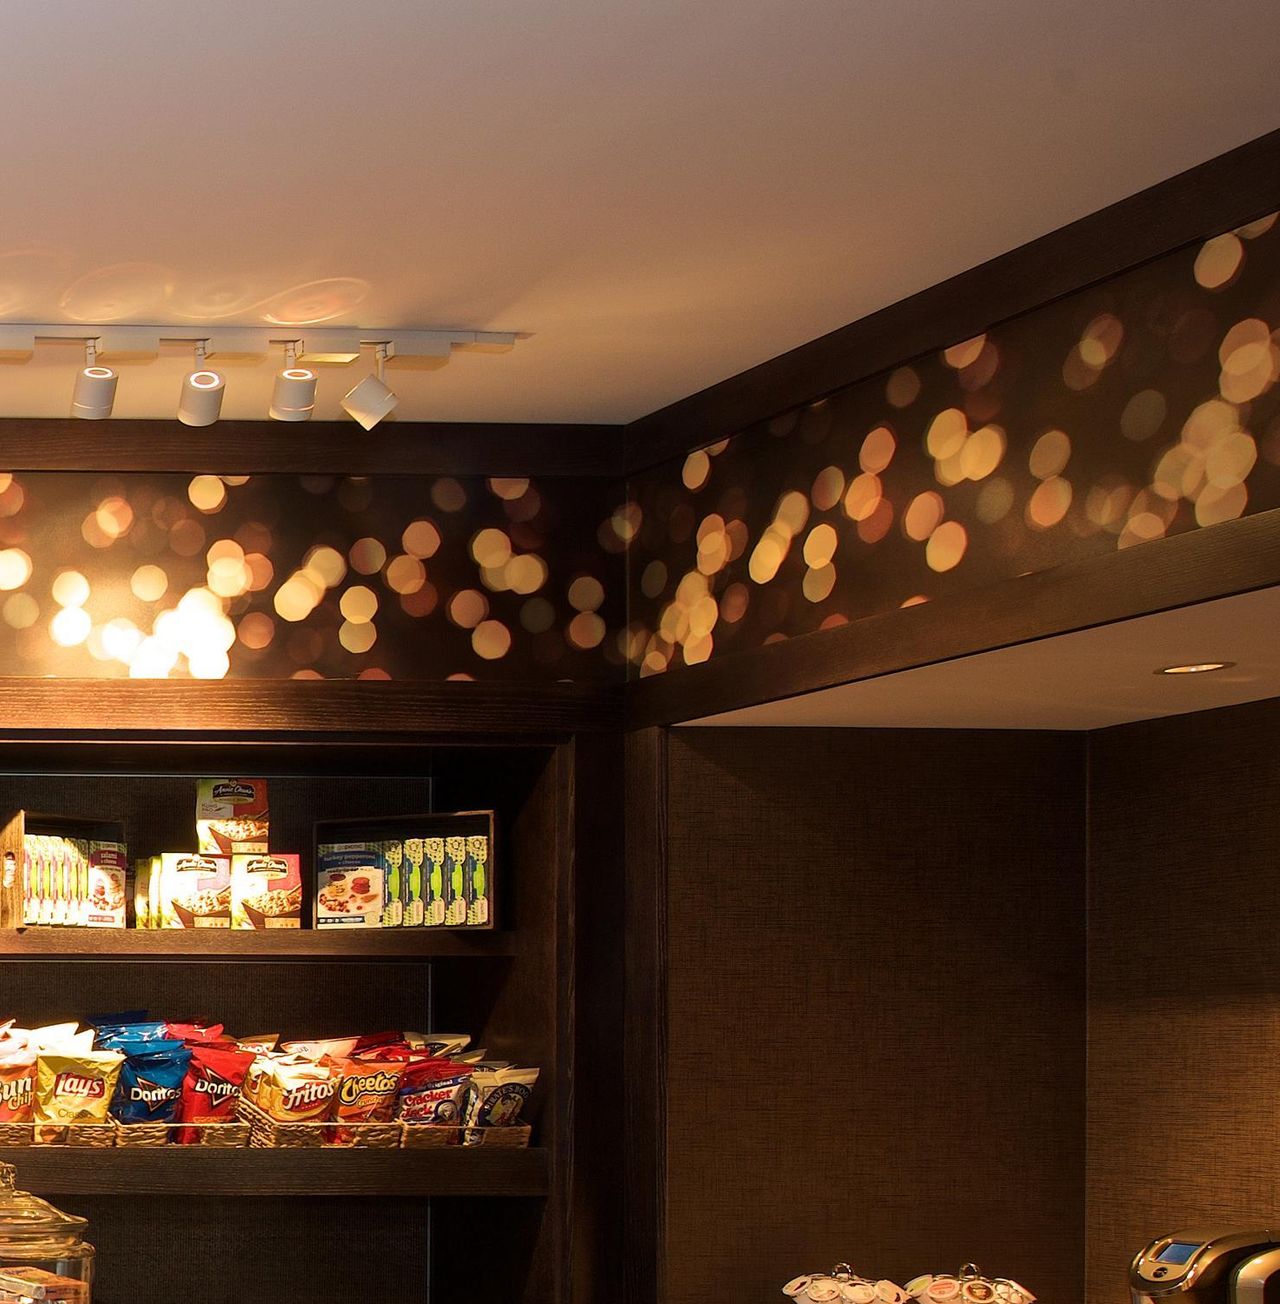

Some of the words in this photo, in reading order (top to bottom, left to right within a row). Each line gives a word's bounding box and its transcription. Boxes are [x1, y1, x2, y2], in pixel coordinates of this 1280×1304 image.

[131, 1086, 182, 1104] Doritos
[283, 1079, 336, 1109] Fritos
[341, 1069, 399, 1105] Cheetos
[405, 1089, 453, 1104] Cracker
[401, 1105, 434, 1118] Jack
